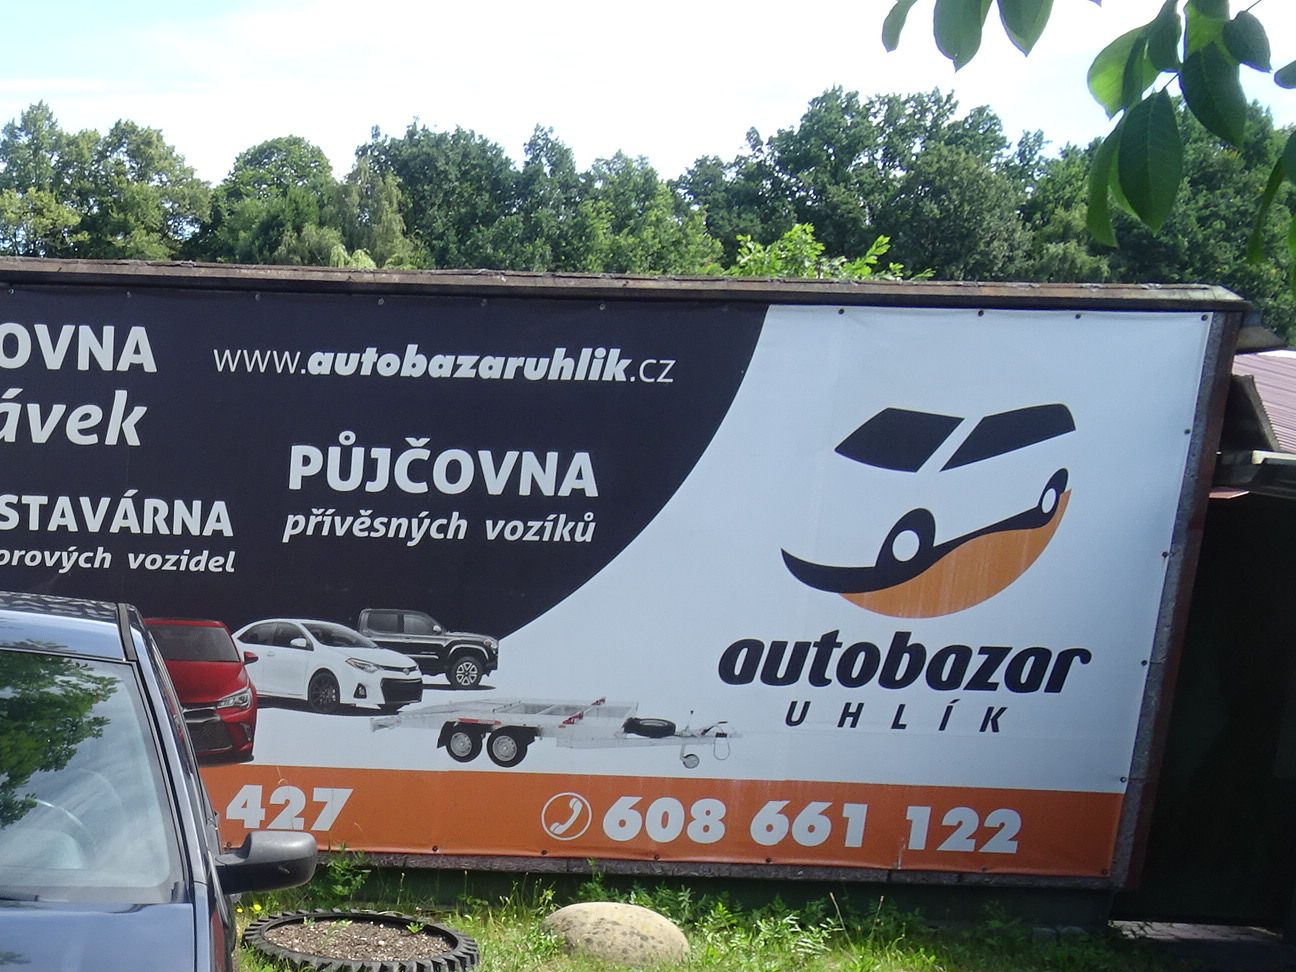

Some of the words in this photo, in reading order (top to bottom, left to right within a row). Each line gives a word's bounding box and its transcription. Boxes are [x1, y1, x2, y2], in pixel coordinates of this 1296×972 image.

[212, 344, 675, 383] www.autobazaruhlik.cz
[288, 430, 599, 497] PŮJČOVNA
[282, 509, 467, 547] přívěsných
[485, 511, 596, 543] vozíků
[127, 548, 235, 574] vozidel
[717, 629, 1092, 694] autobazar
[785, 699, 1008, 734] UHLÍK
[226, 785, 354, 832] 427
[602, 796, 726, 845] 608
[750, 800, 869, 849] 661
[905, 806, 1023, 855] 122
